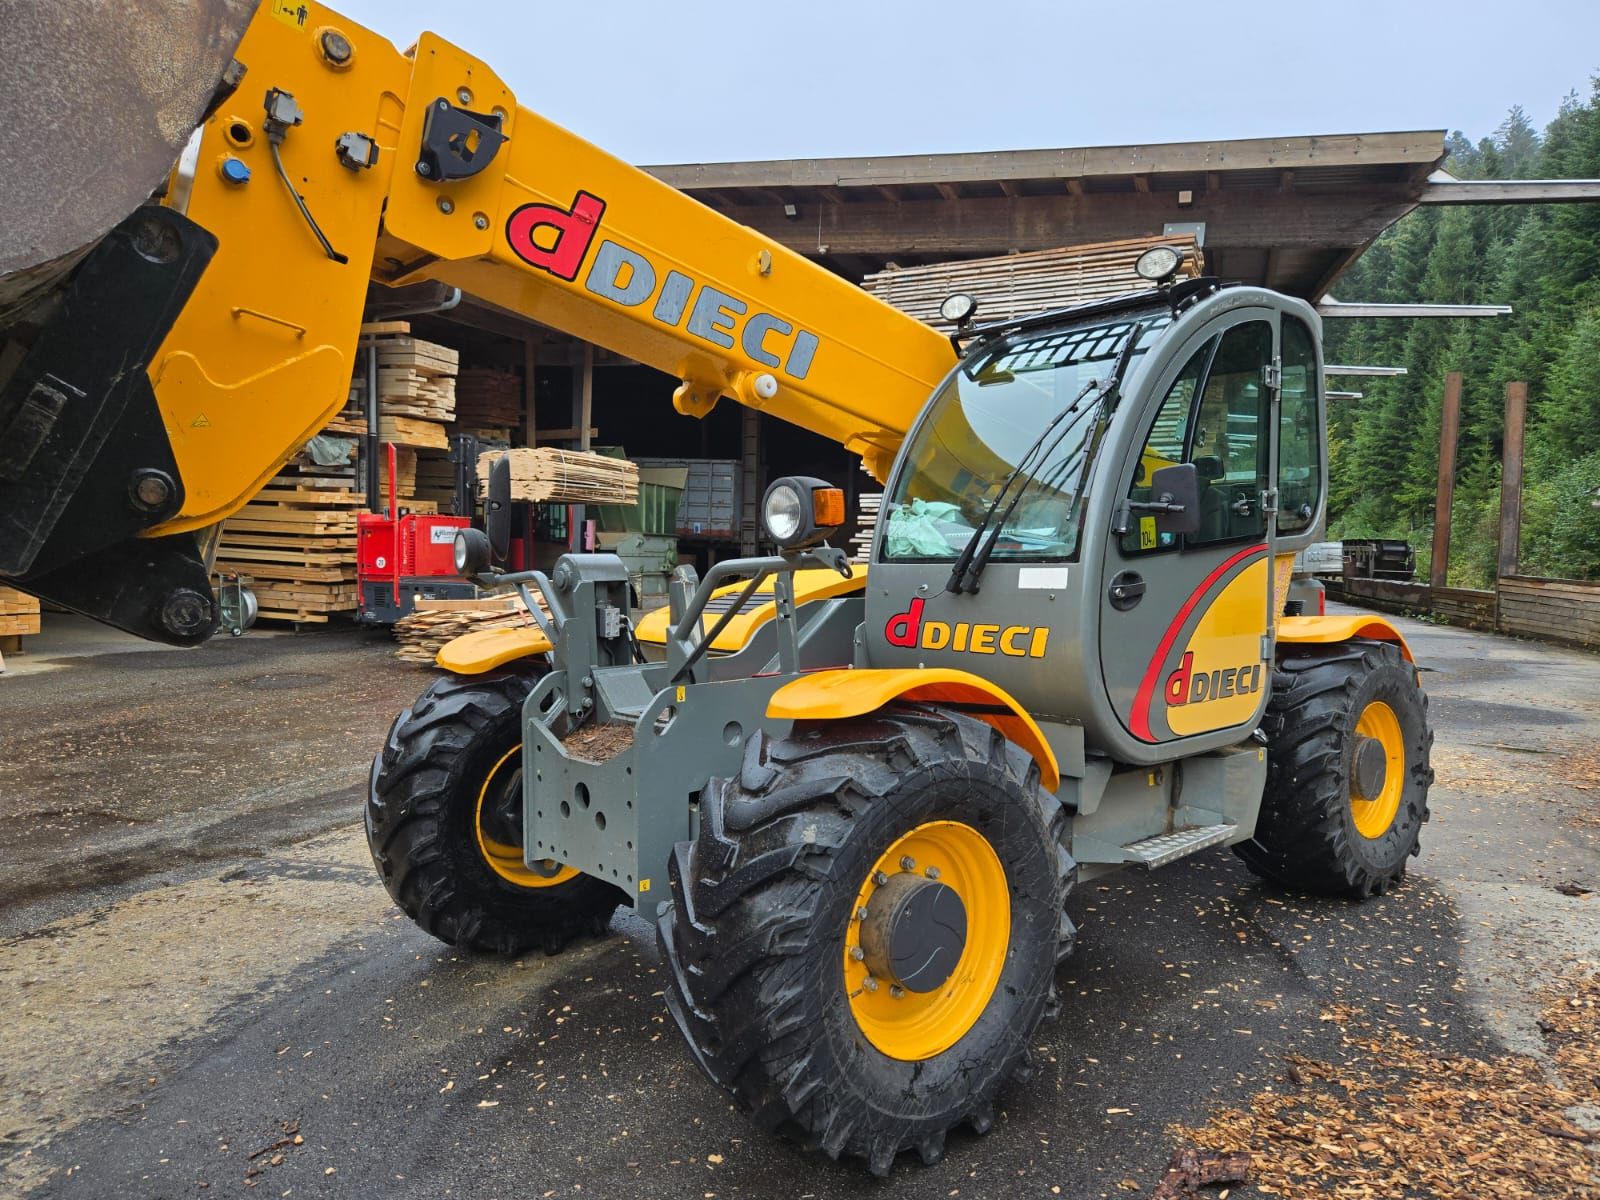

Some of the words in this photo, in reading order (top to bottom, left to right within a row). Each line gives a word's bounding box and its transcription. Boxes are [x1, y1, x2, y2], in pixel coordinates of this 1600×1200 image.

[585, 239, 819, 380] DIECI
[921, 620, 1050, 658] DIECI
[1191, 664, 1261, 703] DIECI
